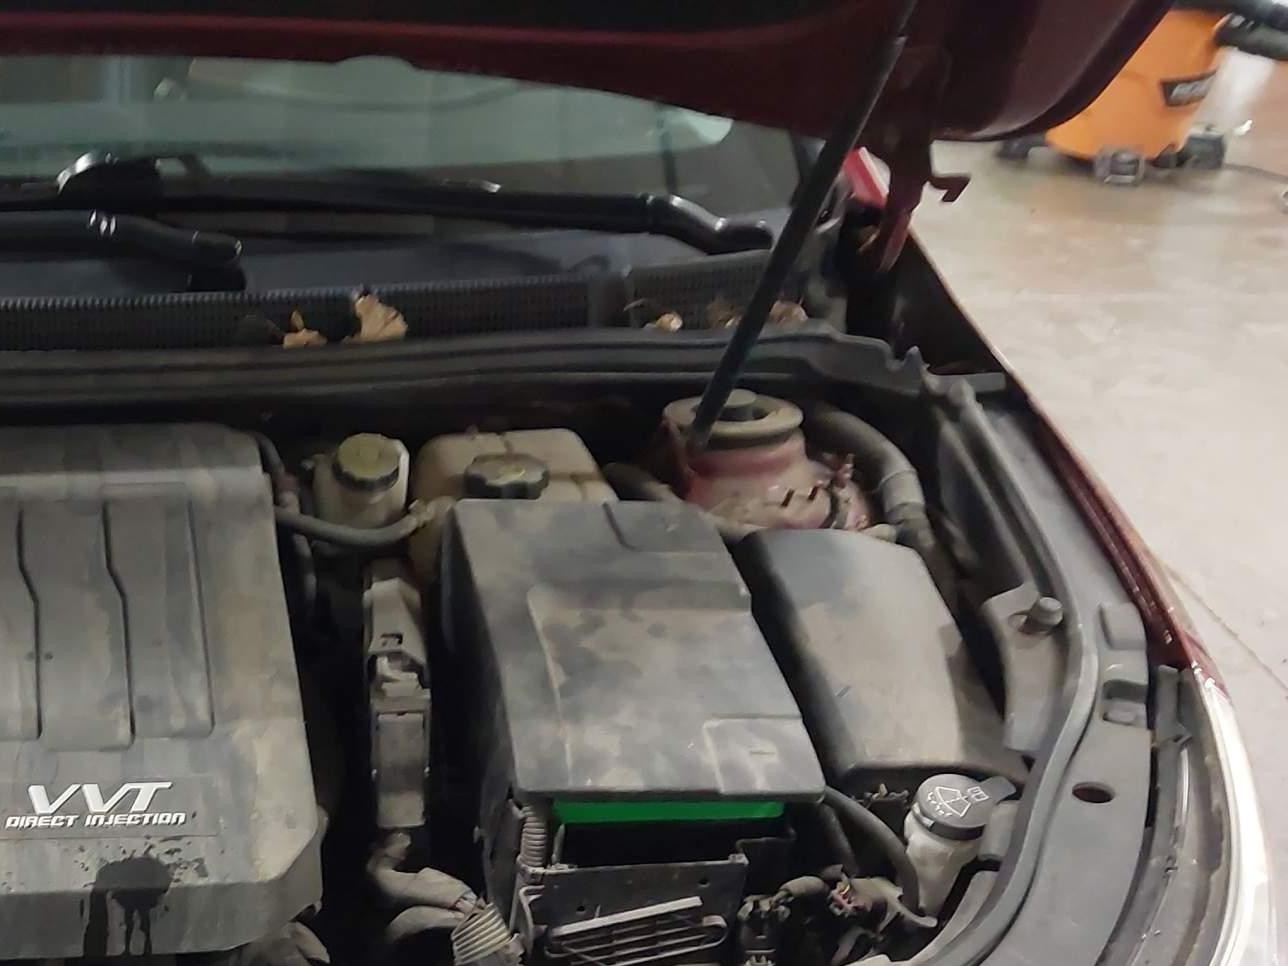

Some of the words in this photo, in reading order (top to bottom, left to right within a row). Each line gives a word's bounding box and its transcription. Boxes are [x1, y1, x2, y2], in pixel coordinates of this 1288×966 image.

[27, 781, 173, 815] VVT
[5, 814, 81, 829] DIRECT
[84, 812, 188, 826] INJECTION
